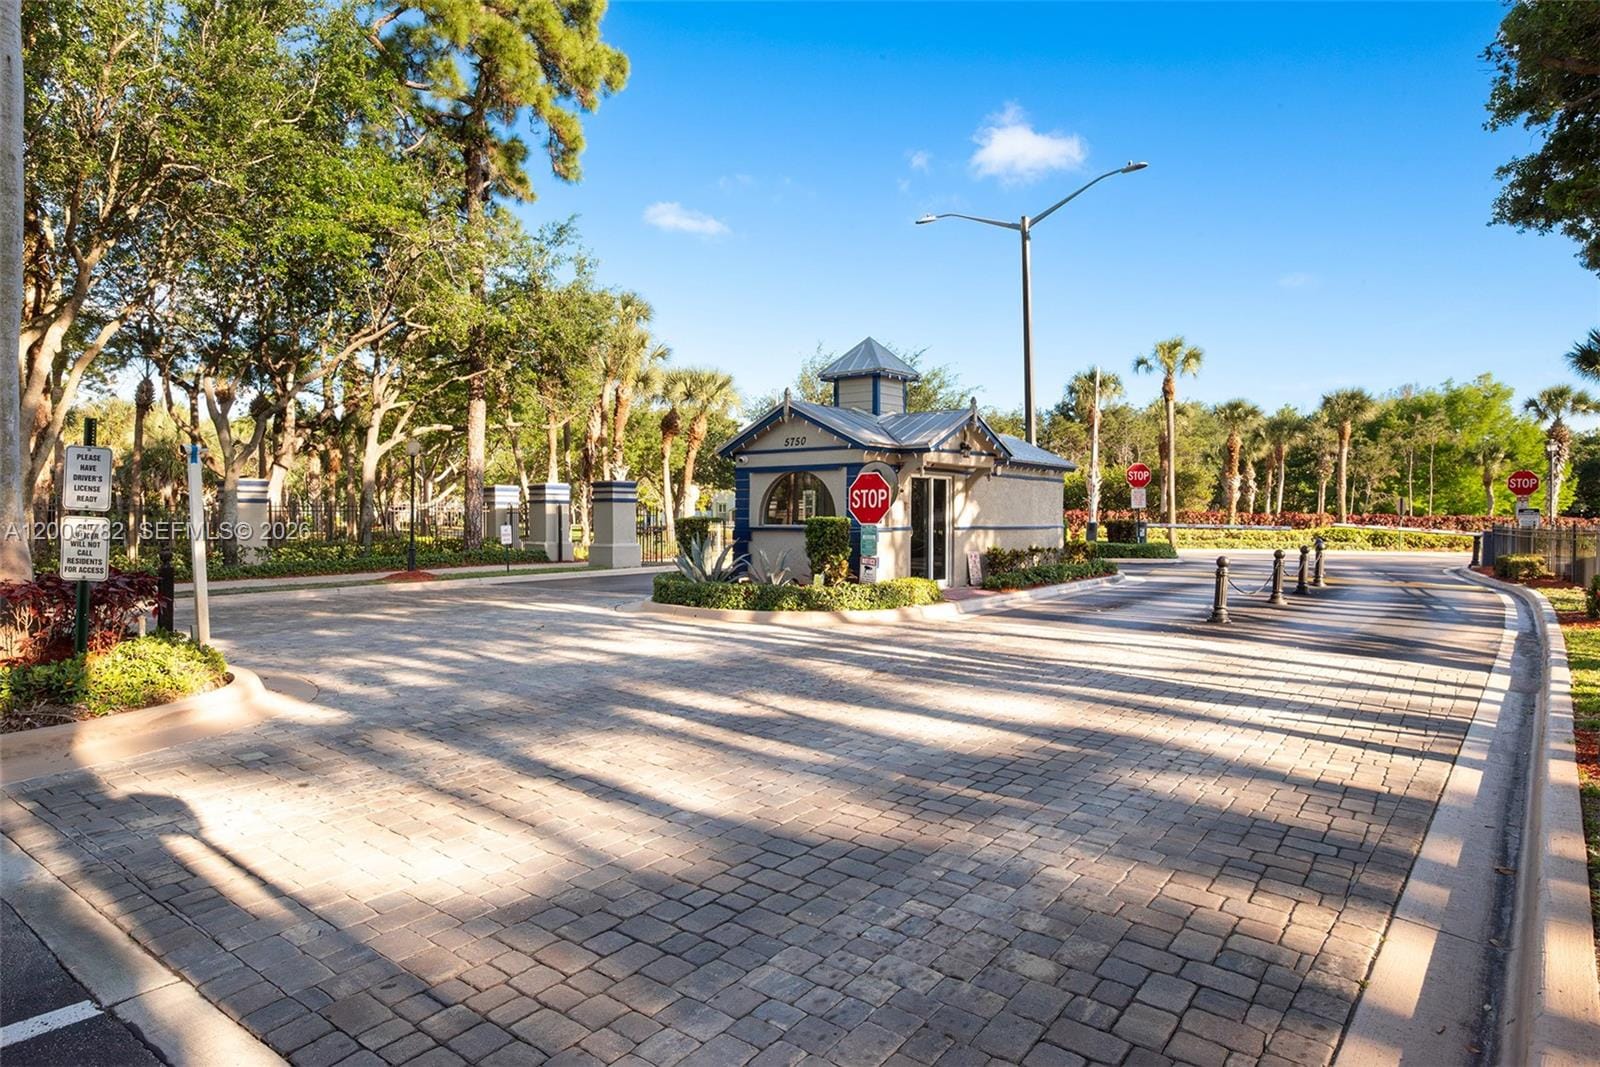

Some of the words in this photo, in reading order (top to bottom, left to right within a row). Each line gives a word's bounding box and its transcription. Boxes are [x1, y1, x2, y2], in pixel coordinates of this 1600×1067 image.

[784, 436, 807, 447] 5750
[76, 453, 102, 462] PLEASE
[80, 464, 97, 472] HAVE
[72, 473, 103, 482] DRIVER'S
[1128, 470, 1150, 481] STOP
[1509, 478, 1538, 489] STOP
[73, 484, 101, 493] LICENSE
[76, 495, 98, 503] READY
[851, 488, 888, 509] STOP
[75, 531, 99, 540] ICER
[70, 540, 86, 548] WILL
[87, 541, 101, 549] NOT
[77, 549, 93, 557] CALL
[66, 557, 103, 566] RESIDENTS
[64, 565, 77, 573] FOR
[78, 566, 104, 575] ACCESS
